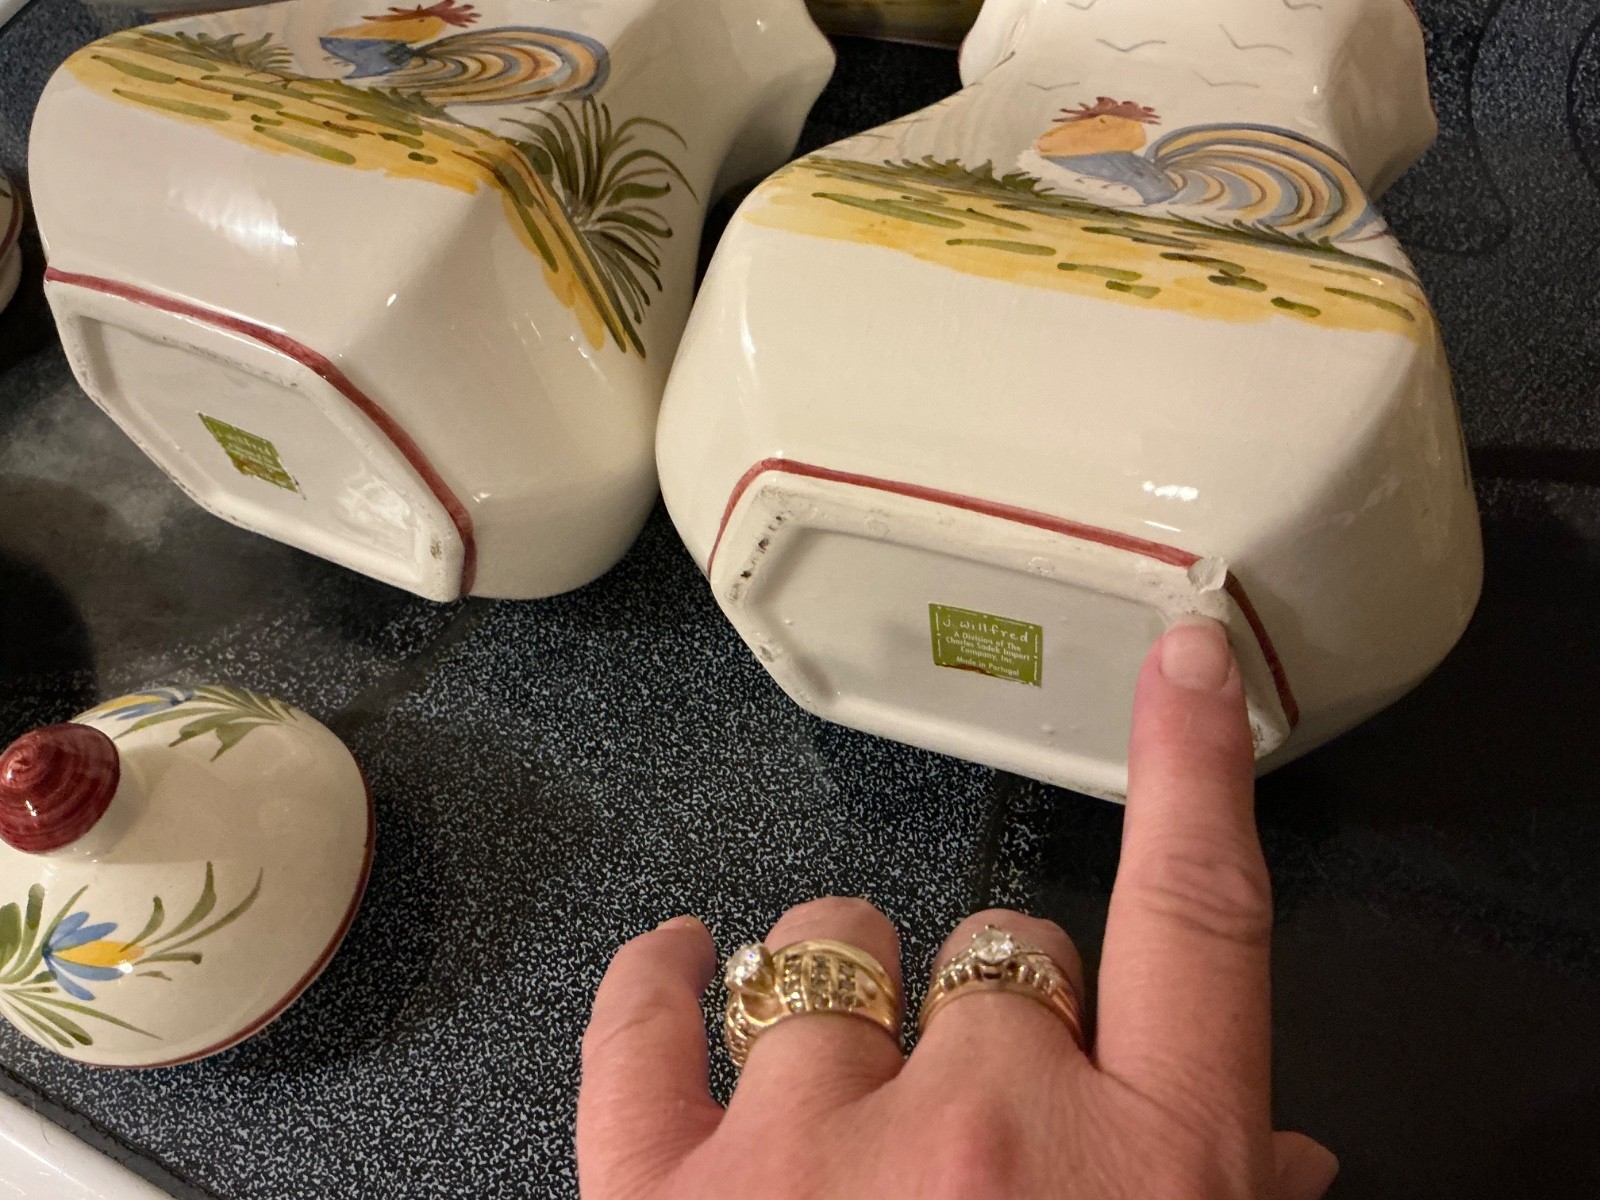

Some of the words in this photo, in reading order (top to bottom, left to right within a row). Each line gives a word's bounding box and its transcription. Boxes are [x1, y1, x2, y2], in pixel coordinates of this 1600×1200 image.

[945, 636, 974, 648] Charles
[977, 642, 1000, 654] Sadek
[1003, 649, 1030, 661] Import
[962, 632, 993, 645] Division
[996, 640, 1004, 648] of
[1007, 642, 1021, 652] The
[956, 656, 976, 666] Made
[988, 662, 1019, 677] Portugal
